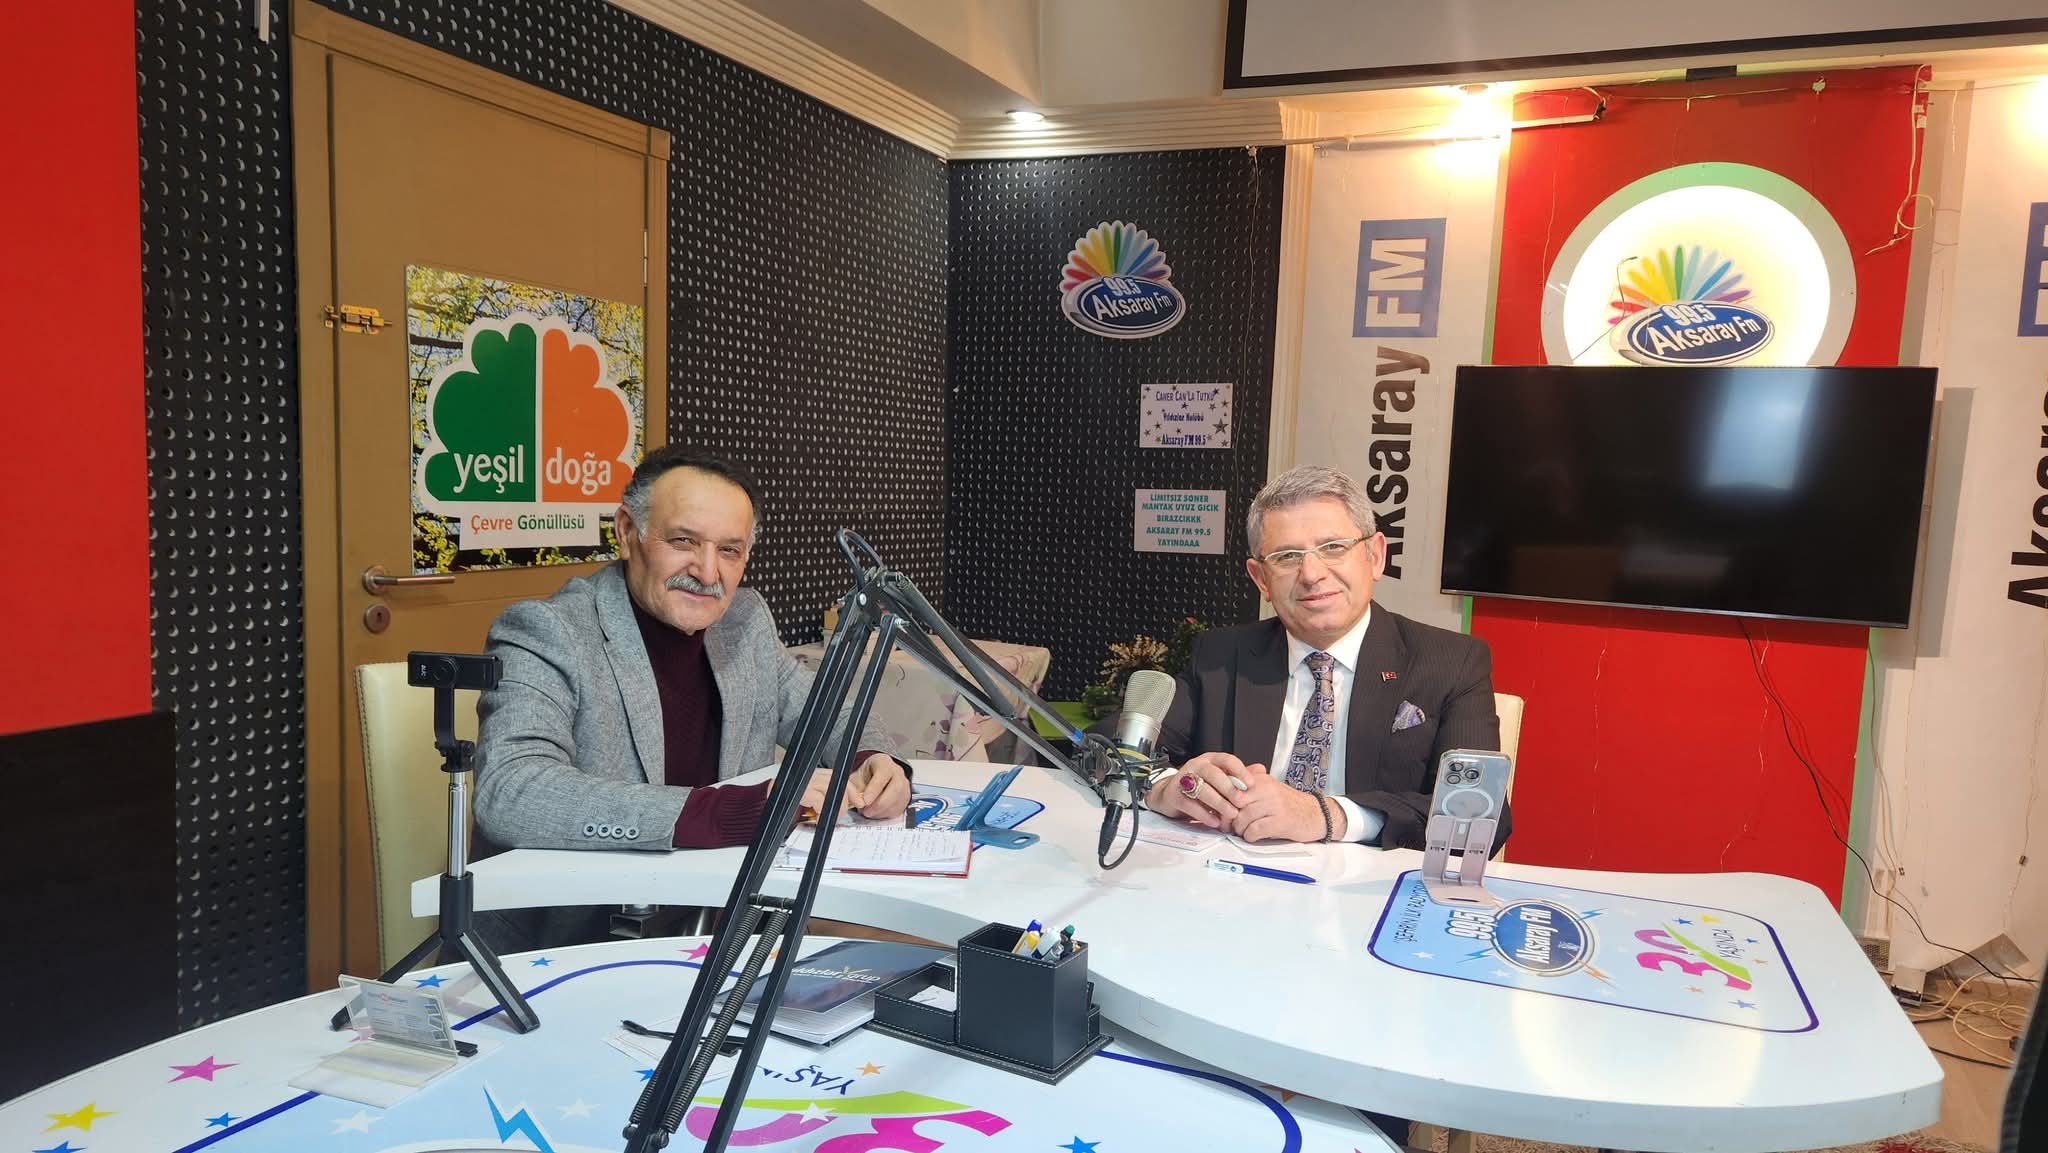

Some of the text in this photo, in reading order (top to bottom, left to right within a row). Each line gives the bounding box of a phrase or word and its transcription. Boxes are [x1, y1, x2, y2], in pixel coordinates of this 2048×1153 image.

[1365, 237, 1429, 329] FM
[1091, 291, 1173, 321] Aksaray Fm
[1646, 316, 1762, 355] Aksaray Fm
[1184, 434, 1194, 445] FM
[453, 444, 611, 496] yeşil doğa
[1175, 503, 1195, 511] UYUZ
[1197, 504, 1219, 512] GICIK
[1183, 494, 1209, 502] SONER
[470, 514, 585, 535] Çevre Gönüllüsü
[1146, 526, 1212, 536] AKSARAY FM 99.5
[1516, 922, 1559, 963] Aksaray
